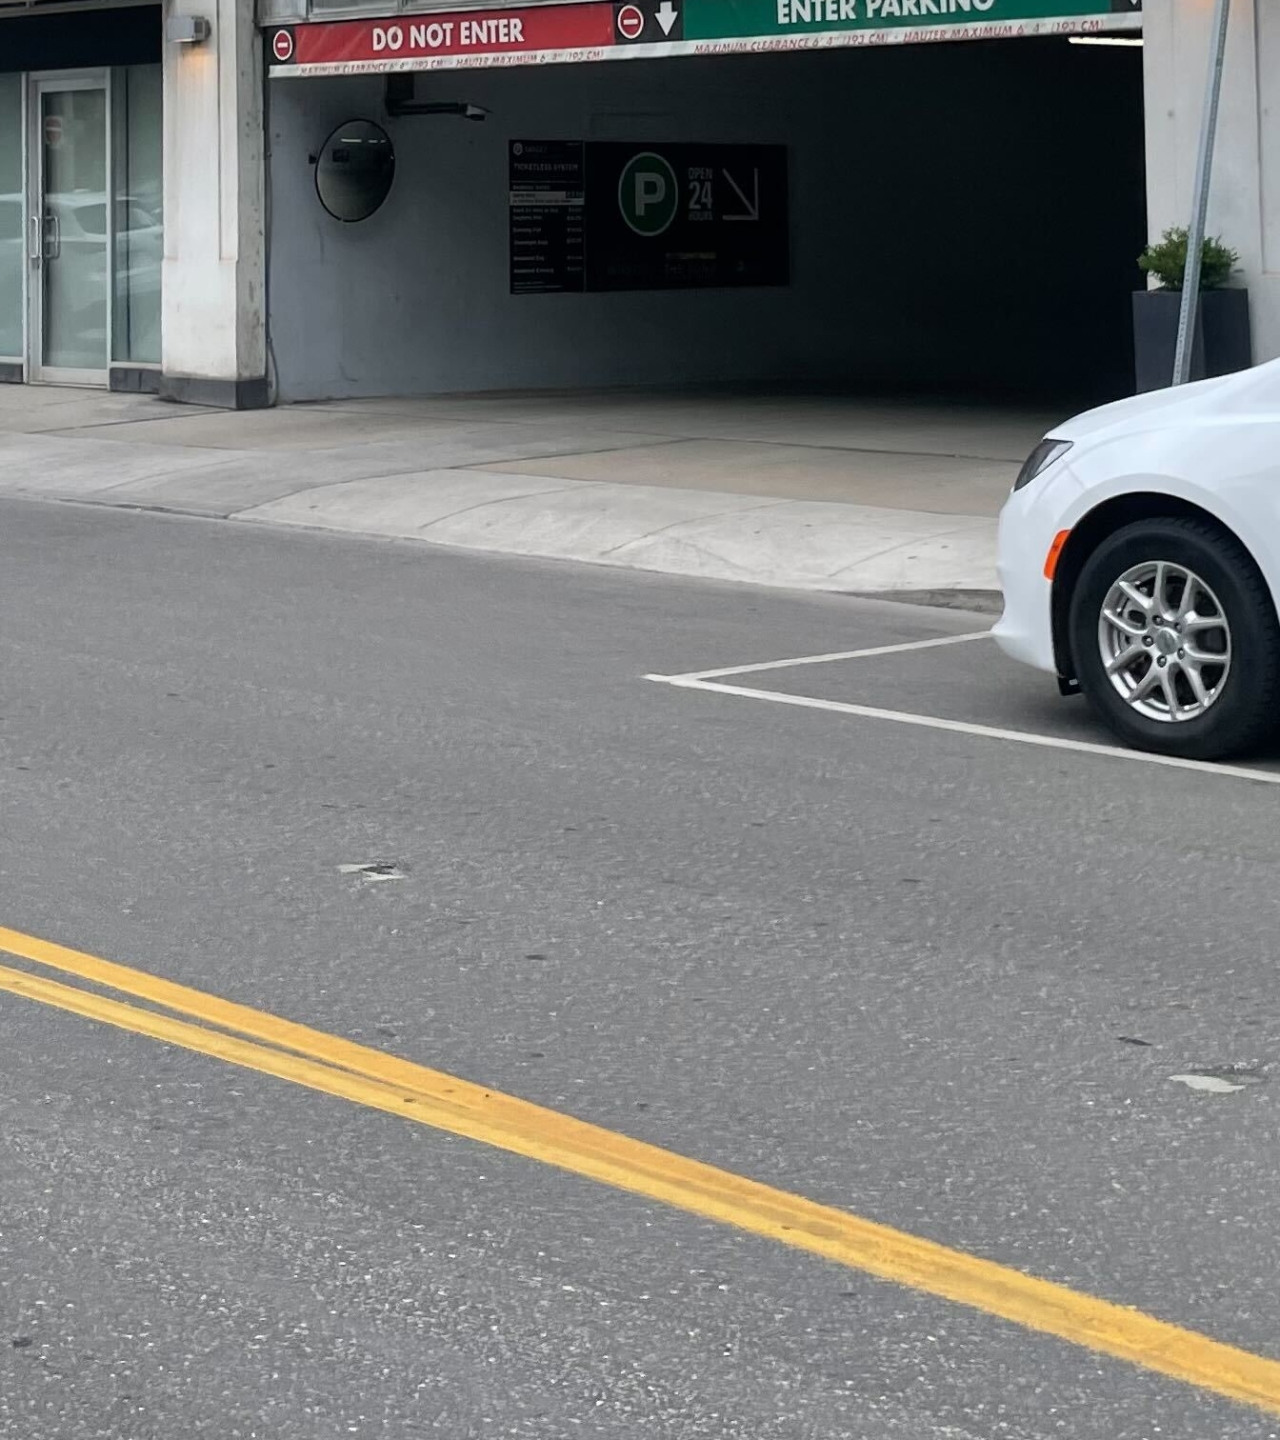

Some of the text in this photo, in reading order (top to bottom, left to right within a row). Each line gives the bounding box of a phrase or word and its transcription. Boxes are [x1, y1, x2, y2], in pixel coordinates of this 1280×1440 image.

[372, 18, 525, 51] DO NOT ENTER
[694, 42, 747, 54] MAXIMUM
[750, 39, 809, 52] CLEARANCE
[949, 25, 1013, 40] MAXIMUM
[687, 167, 714, 180] OPEN
[634, 171, 666, 216] P
[687, 180, 714, 211] 24
[687, 210, 714, 222] HOURS
